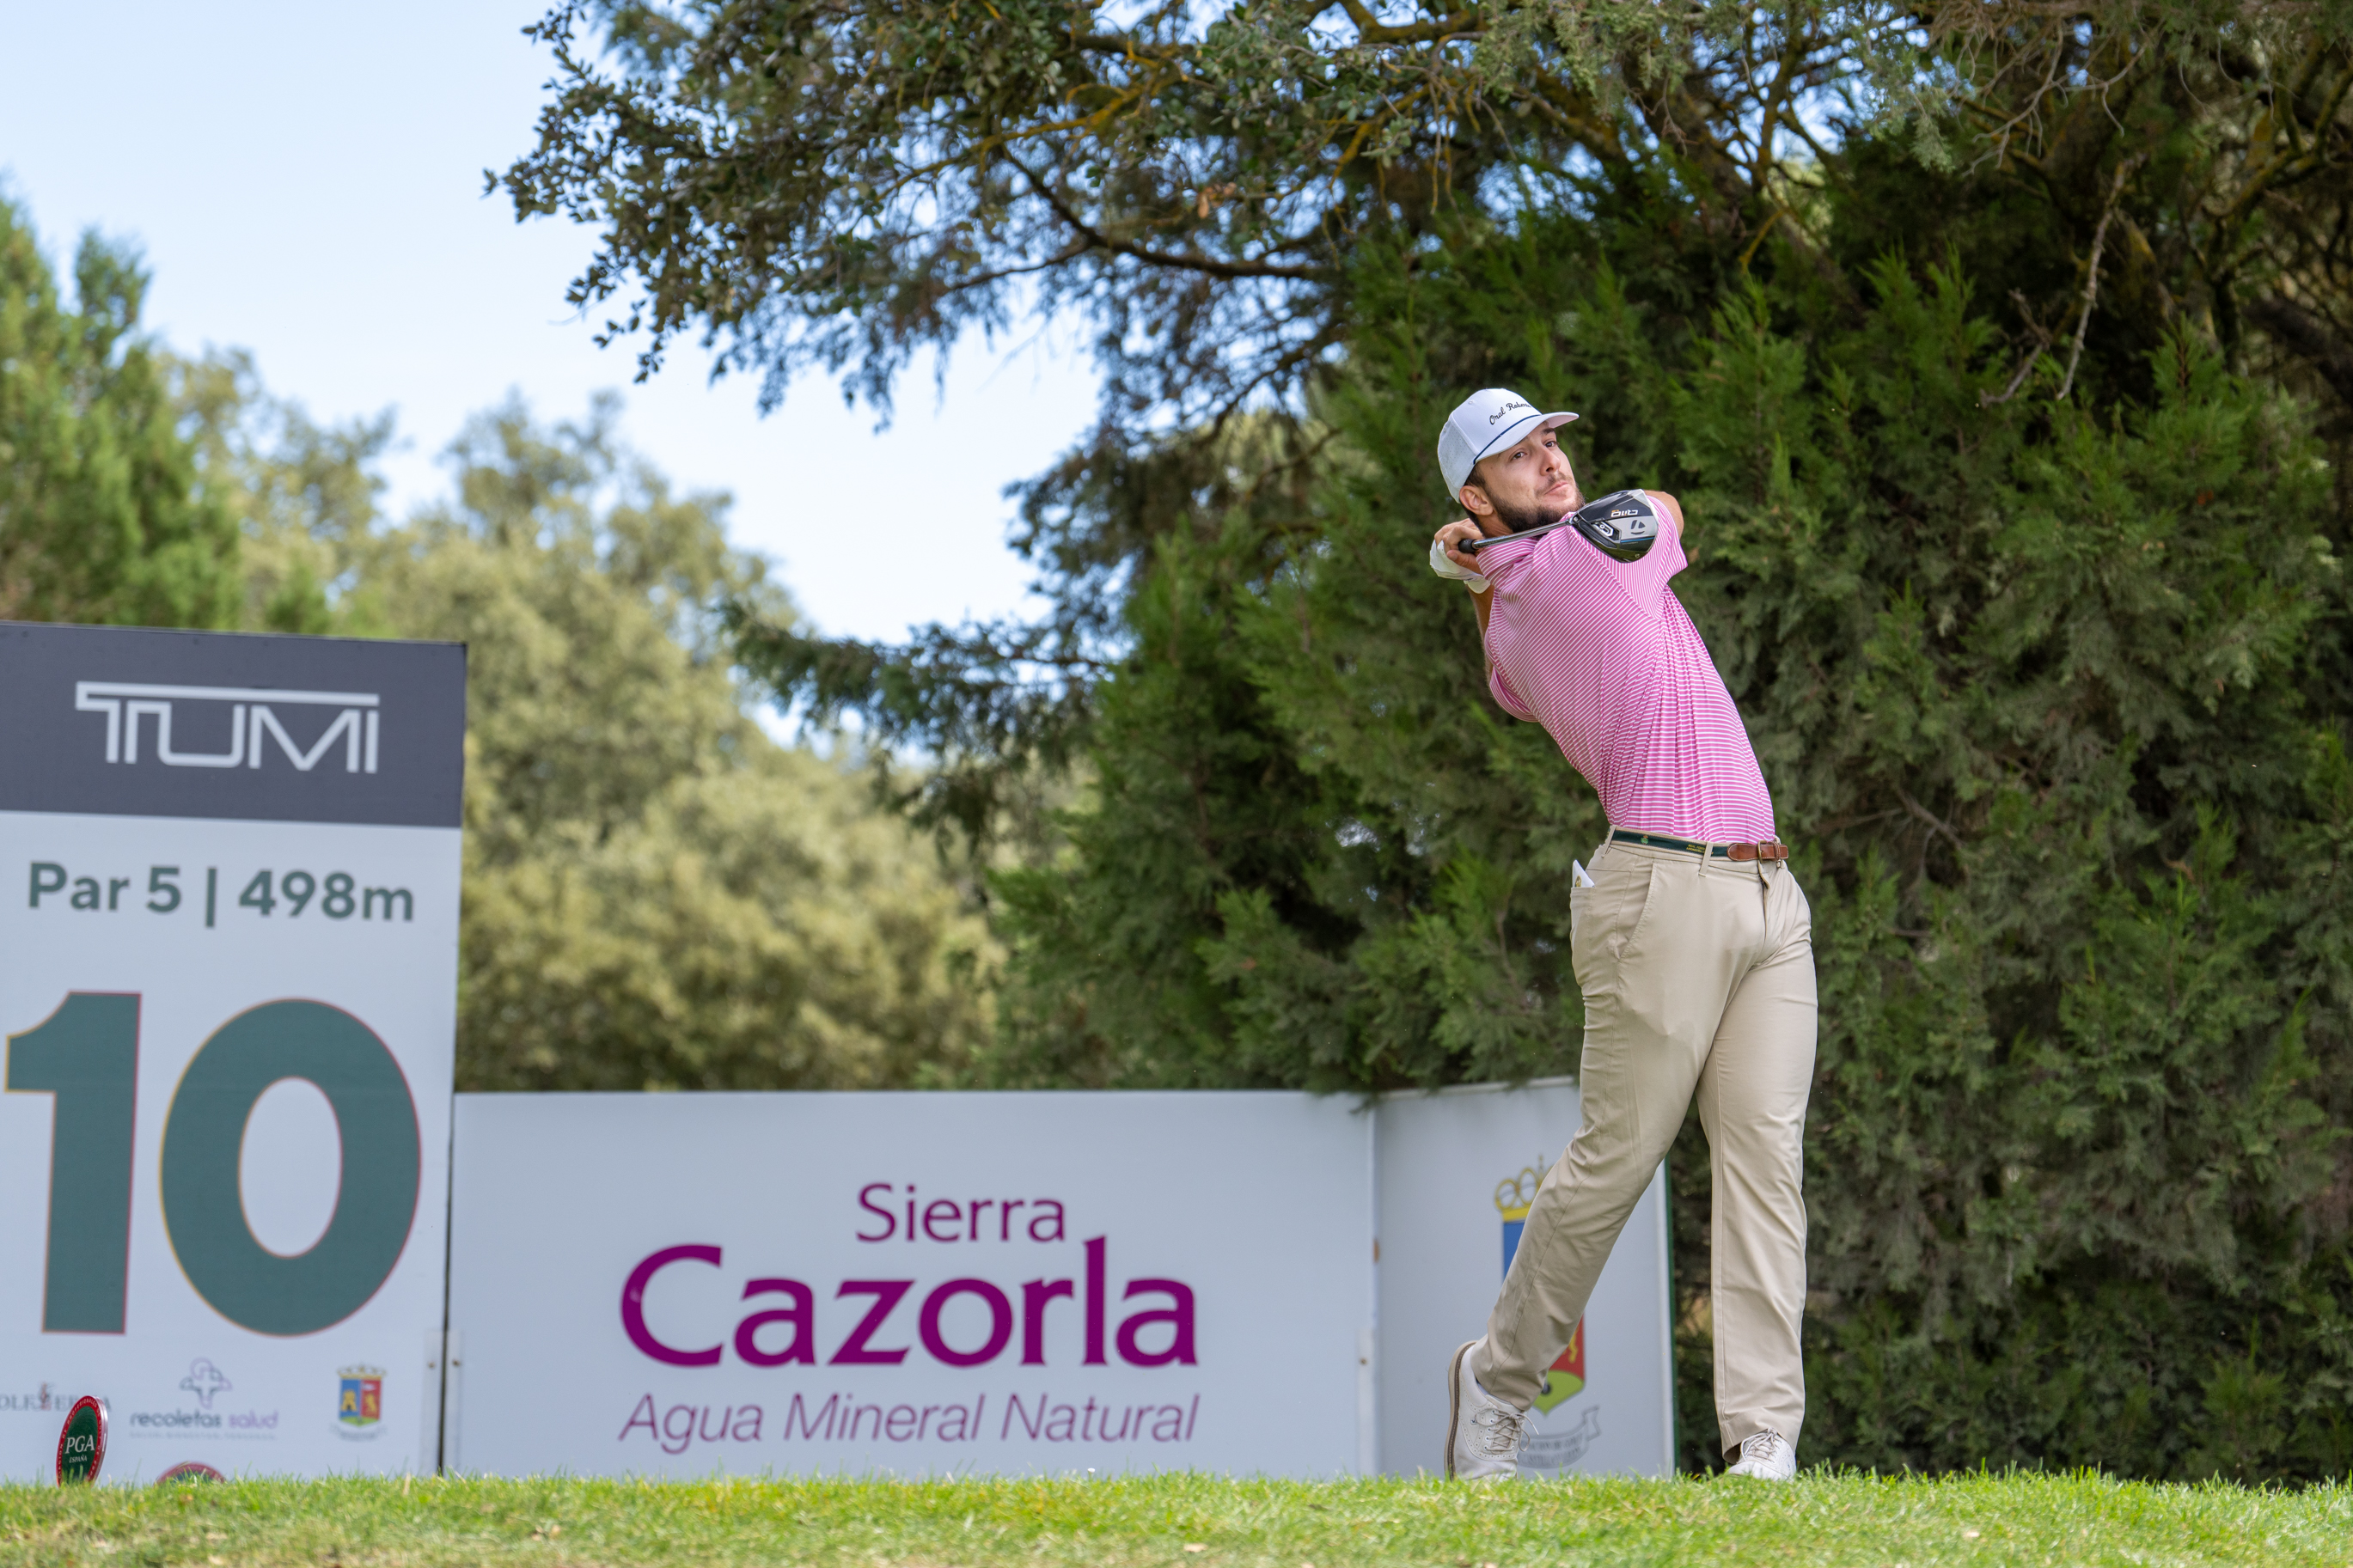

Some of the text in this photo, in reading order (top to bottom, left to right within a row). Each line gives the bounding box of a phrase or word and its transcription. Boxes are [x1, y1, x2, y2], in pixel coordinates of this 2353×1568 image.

[1488, 406, 1506, 425] Oral
[76, 680, 380, 774] TUMI
[28, 861, 131, 911] Par
[145, 865, 181, 914] 5
[238, 869, 415, 922] 498m
[3, 990, 423, 1339] 10
[855, 1181, 1066, 1243] Sierra
[619, 1235, 1200, 1369] Cazorla
[64, 1434, 95, 1454] PGA
[130, 1407, 279, 1430] recoletas salud
[617, 1393, 1201, 1455] Agua Mineral Natural
[69, 1454, 88, 1463] ESPAÑA
